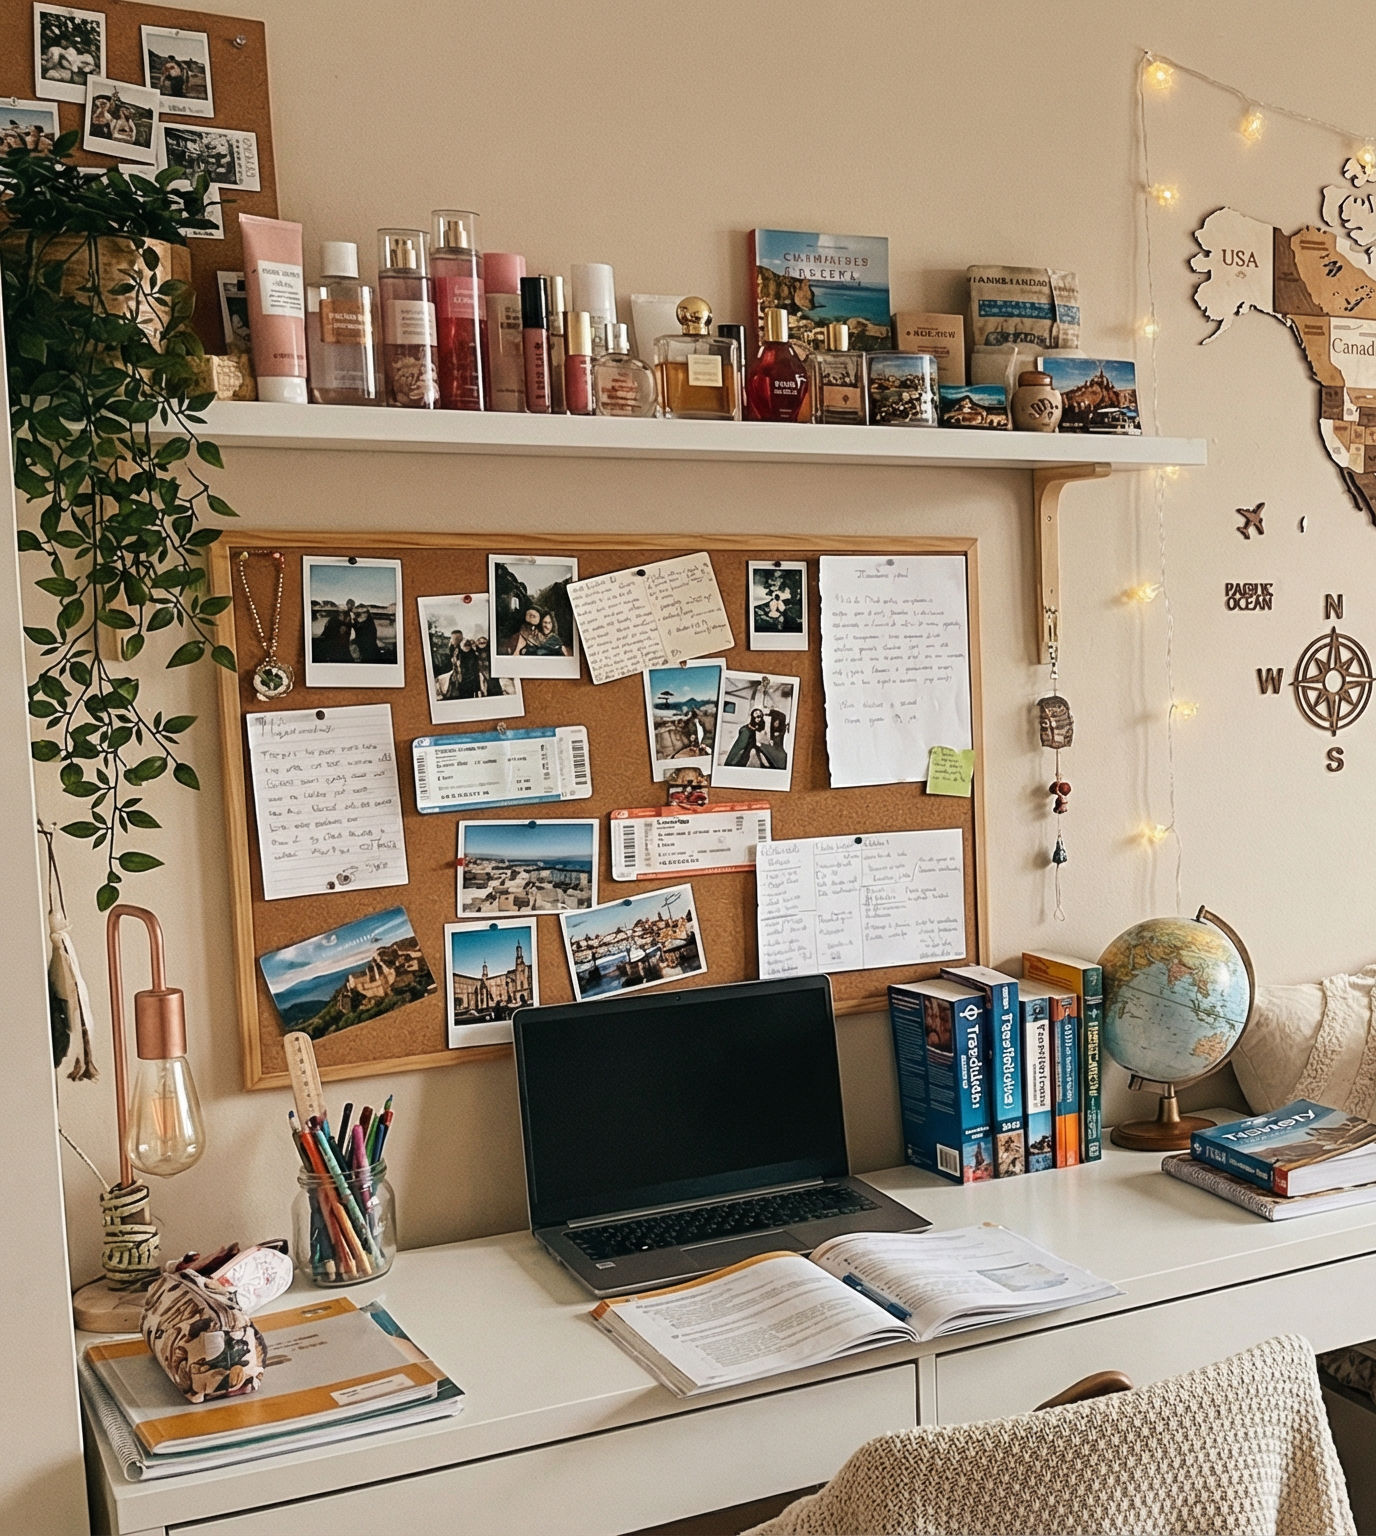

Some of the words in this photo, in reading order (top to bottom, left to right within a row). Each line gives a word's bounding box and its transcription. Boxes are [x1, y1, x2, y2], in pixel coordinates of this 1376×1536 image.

[1222, 249, 1259, 268] USA
[1325, 593, 1343, 620] N
[1256, 667, 1284, 694] W
[1326, 746, 1345, 772] S
